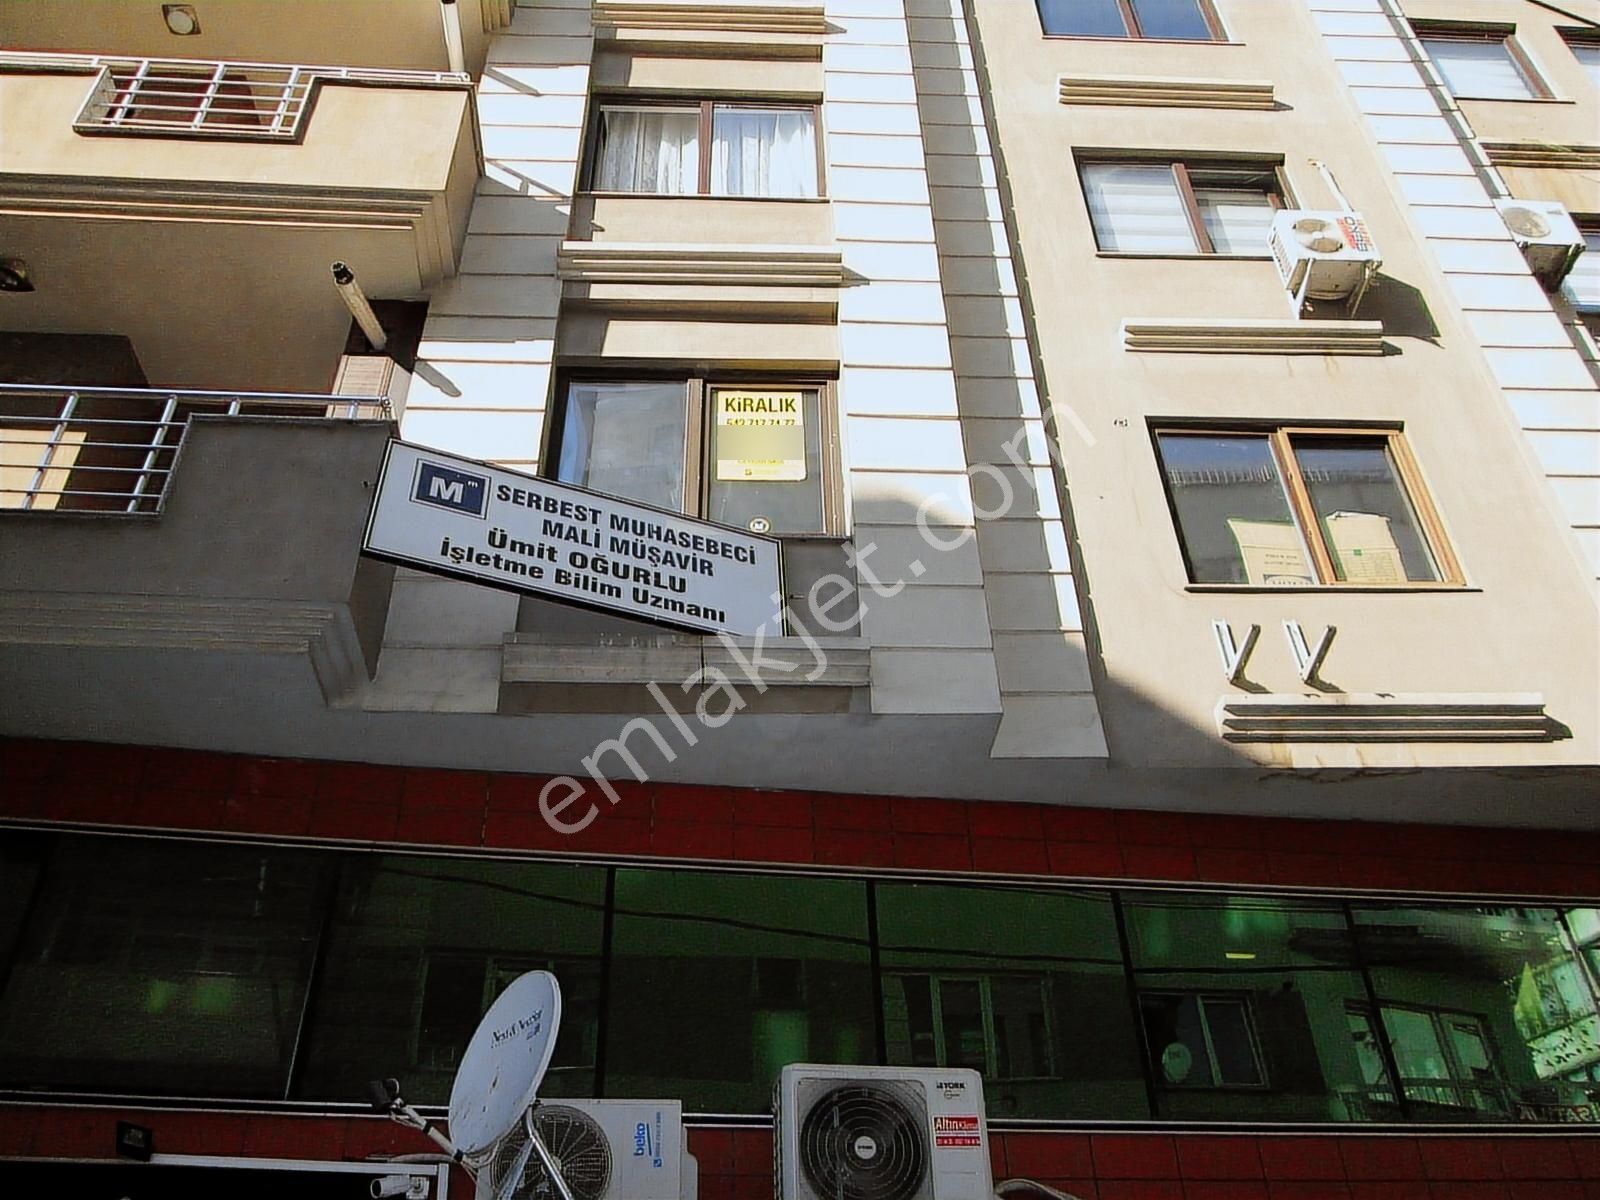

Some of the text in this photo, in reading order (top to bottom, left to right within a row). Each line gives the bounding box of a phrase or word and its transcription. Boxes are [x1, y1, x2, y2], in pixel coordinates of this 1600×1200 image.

[497, 485, 756, 565] SERBEST MUHASEBECİ
[543, 519, 714, 576] MALİ MÜŞAVİR
[440, 537, 726, 623] İşletme Bilim Uzmanı
[488, 528, 687, 592] Ümit OĞURLU
[633, 1122, 645, 1156] beko
